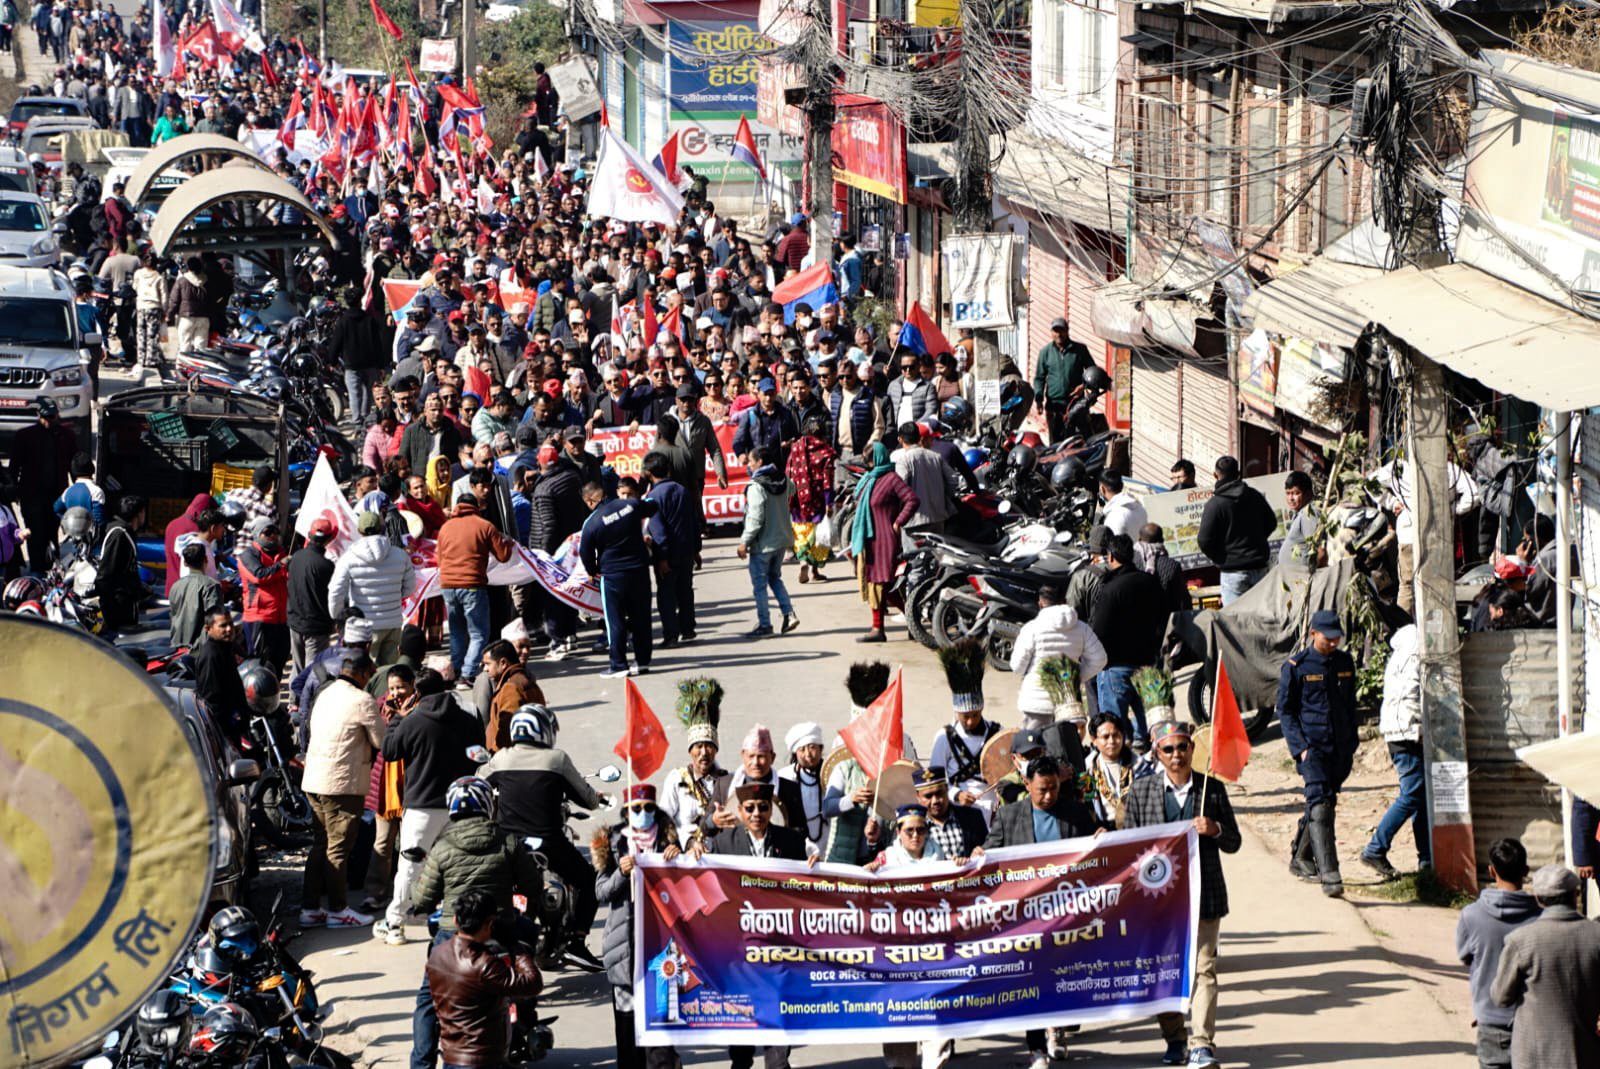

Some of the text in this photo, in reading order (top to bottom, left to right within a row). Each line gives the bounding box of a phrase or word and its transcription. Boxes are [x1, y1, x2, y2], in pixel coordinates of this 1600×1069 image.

[739, 900, 794, 935] नेकपा
[800, 900, 865, 935] (एमाले)
[870, 901, 897, 935] को
[1024, 879, 1122, 921] महाधिवेशन
[884, 943, 946, 964] साथ
[954, 933, 1044, 959] सफल
[7, 907, 176, 1056] निगम लि.
[780, 986, 1040, 1015] Democratic Tamang Association of Nepal (DETAN)
